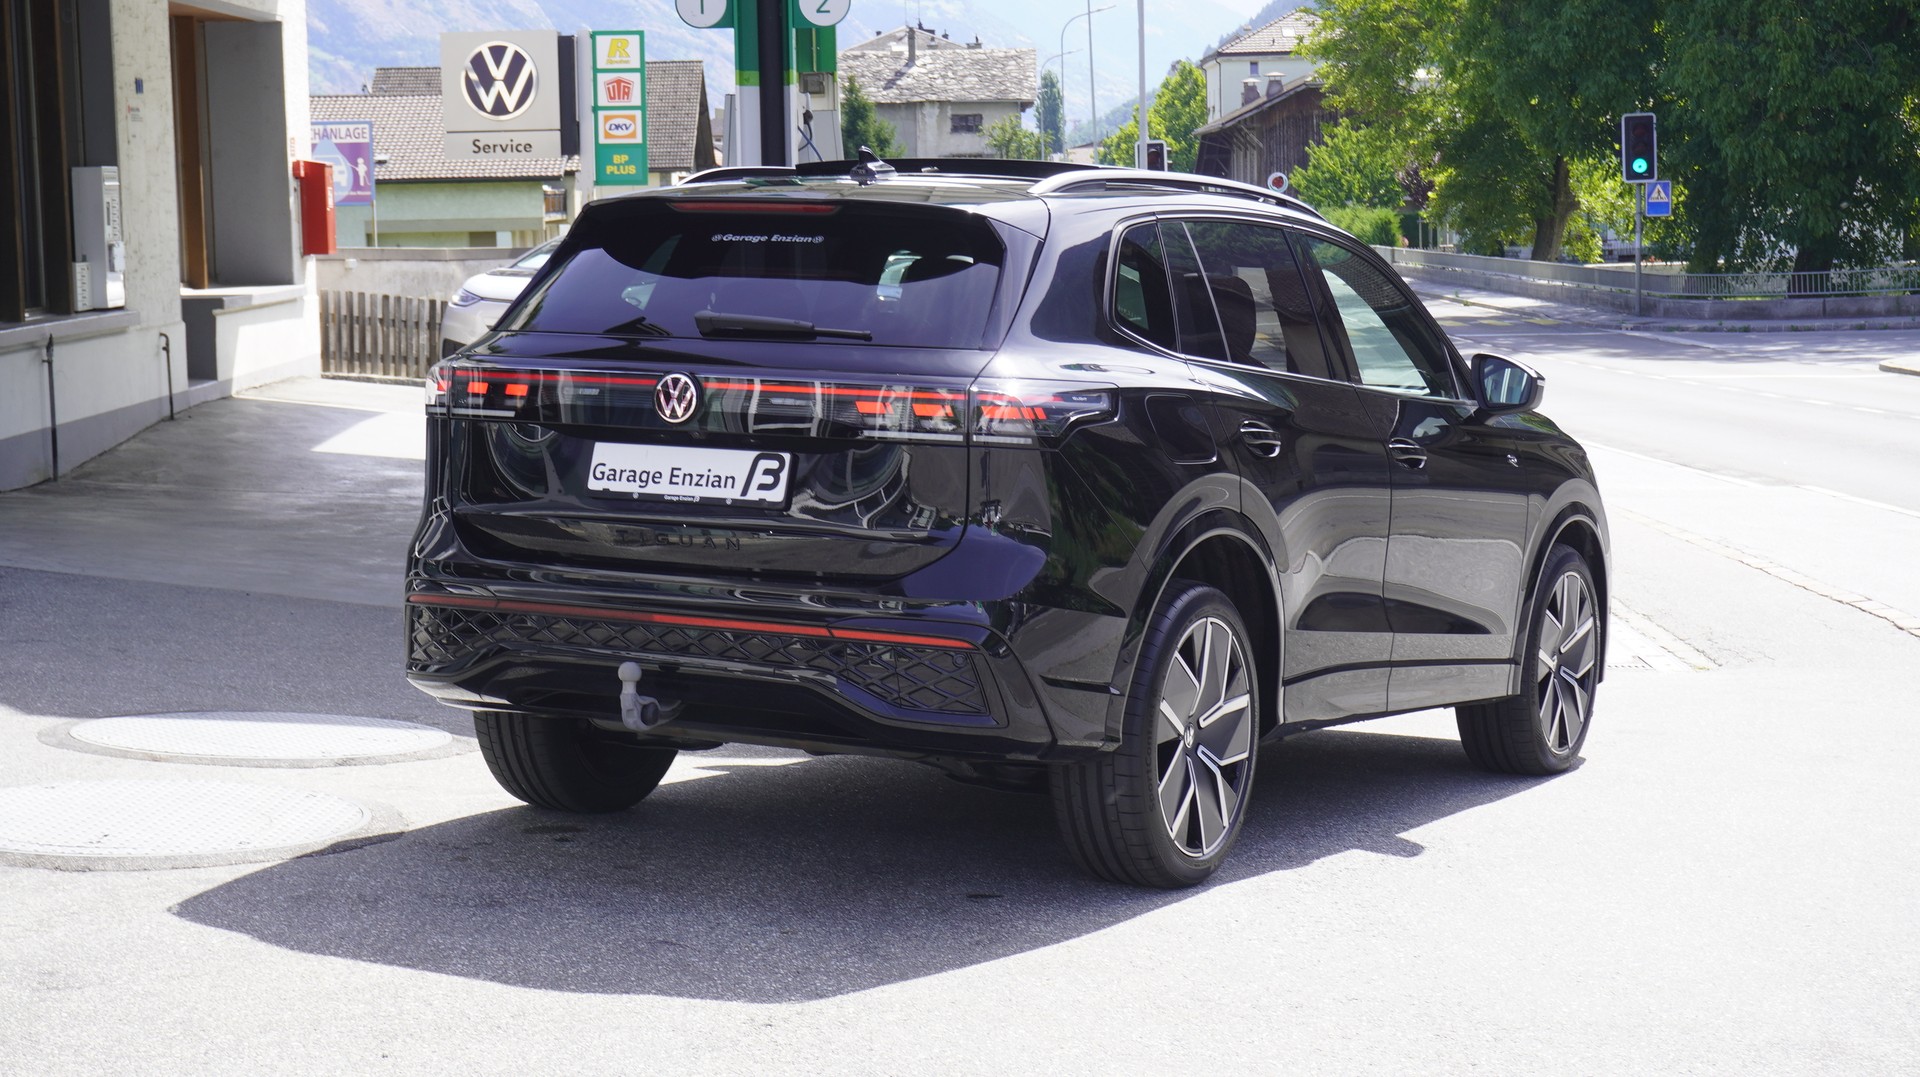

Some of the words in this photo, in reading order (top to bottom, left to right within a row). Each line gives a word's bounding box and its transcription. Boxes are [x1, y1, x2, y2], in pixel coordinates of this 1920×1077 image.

[606, 79, 632, 100] UTA
[608, 123, 632, 131] DKV
[472, 139, 533, 154] Service
[612, 154, 629, 164] BP
[606, 164, 636, 175] PLUS
[722, 234, 768, 243] Garage
[771, 234, 812, 243] Enzian
[592, 462, 663, 488] Garage
[668, 466, 736, 489] Enzian
[614, 529, 740, 551] TIGUAN
